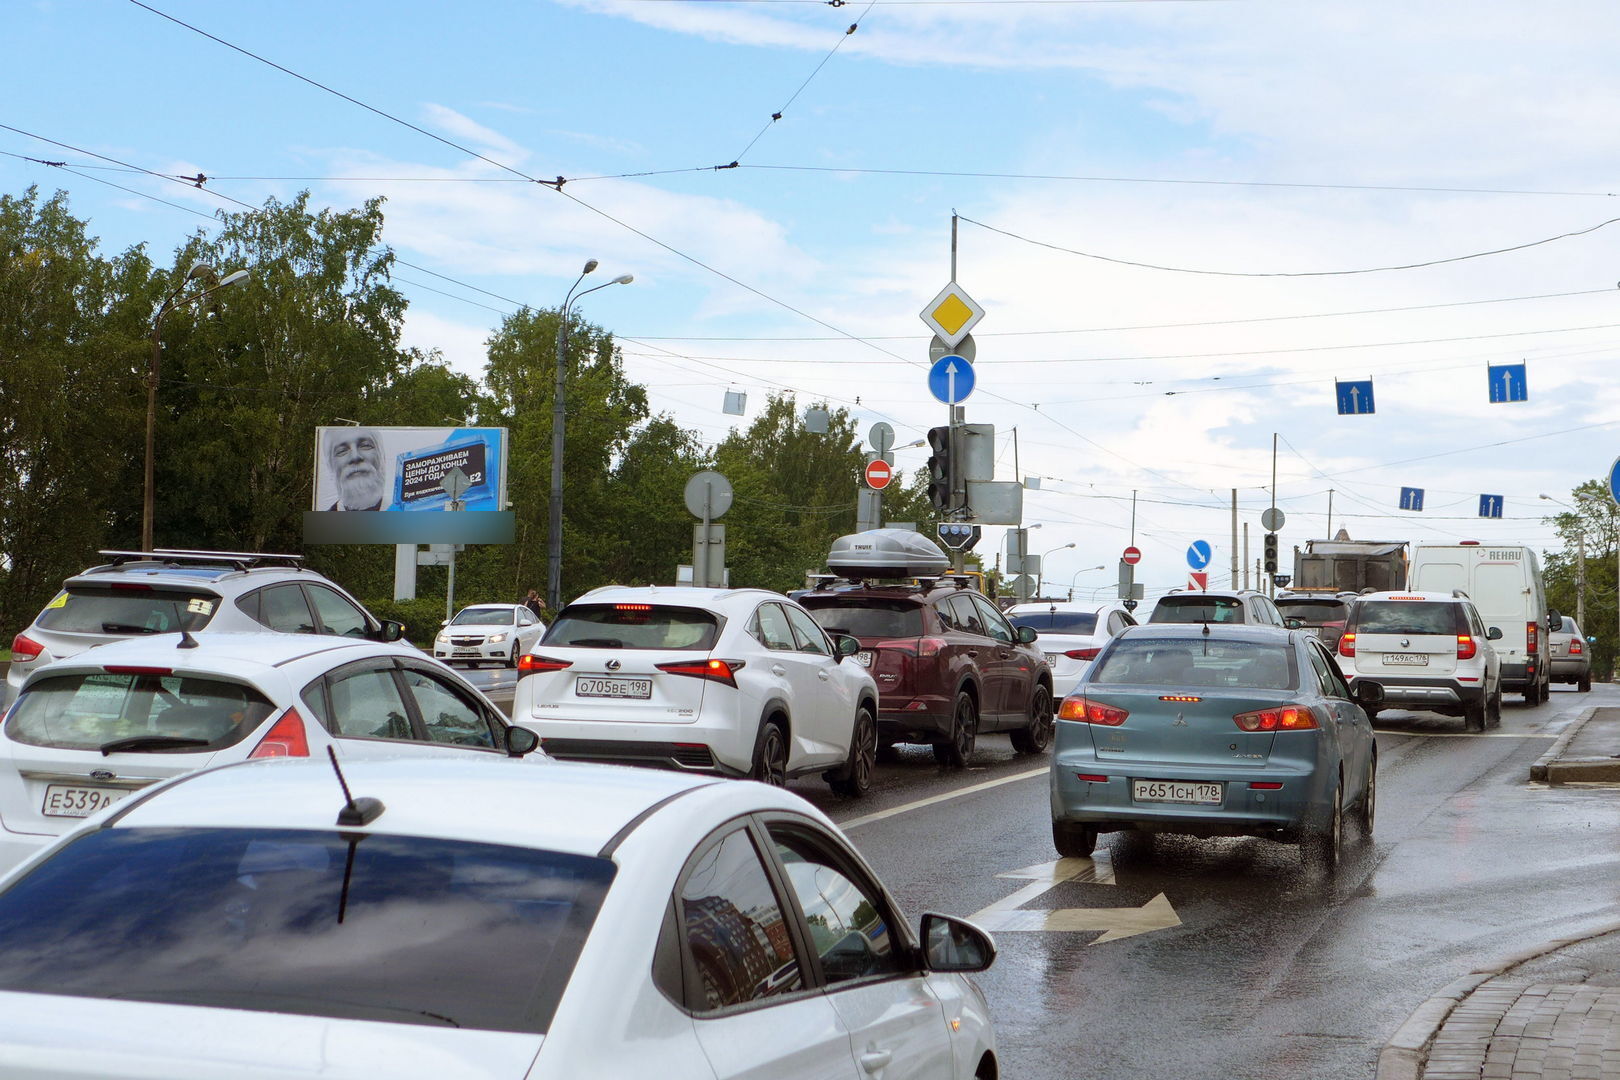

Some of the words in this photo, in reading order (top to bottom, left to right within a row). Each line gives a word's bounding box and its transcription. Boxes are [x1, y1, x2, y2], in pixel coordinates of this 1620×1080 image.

[405, 450, 469, 471] ЗАМОРАЖИВАЕМ
[405, 468, 427, 478] ЦЕНЫ
[428, 464, 441, 473] ДО
[441, 458, 468, 470] КОНЦА
[404, 476, 423, 486] 2024
[424, 471, 445, 482] ГОДА
[1489, 551, 1522, 560] REHAU
[630, 681, 647, 692] 198
[1197, 785, 1218, 796] 178
